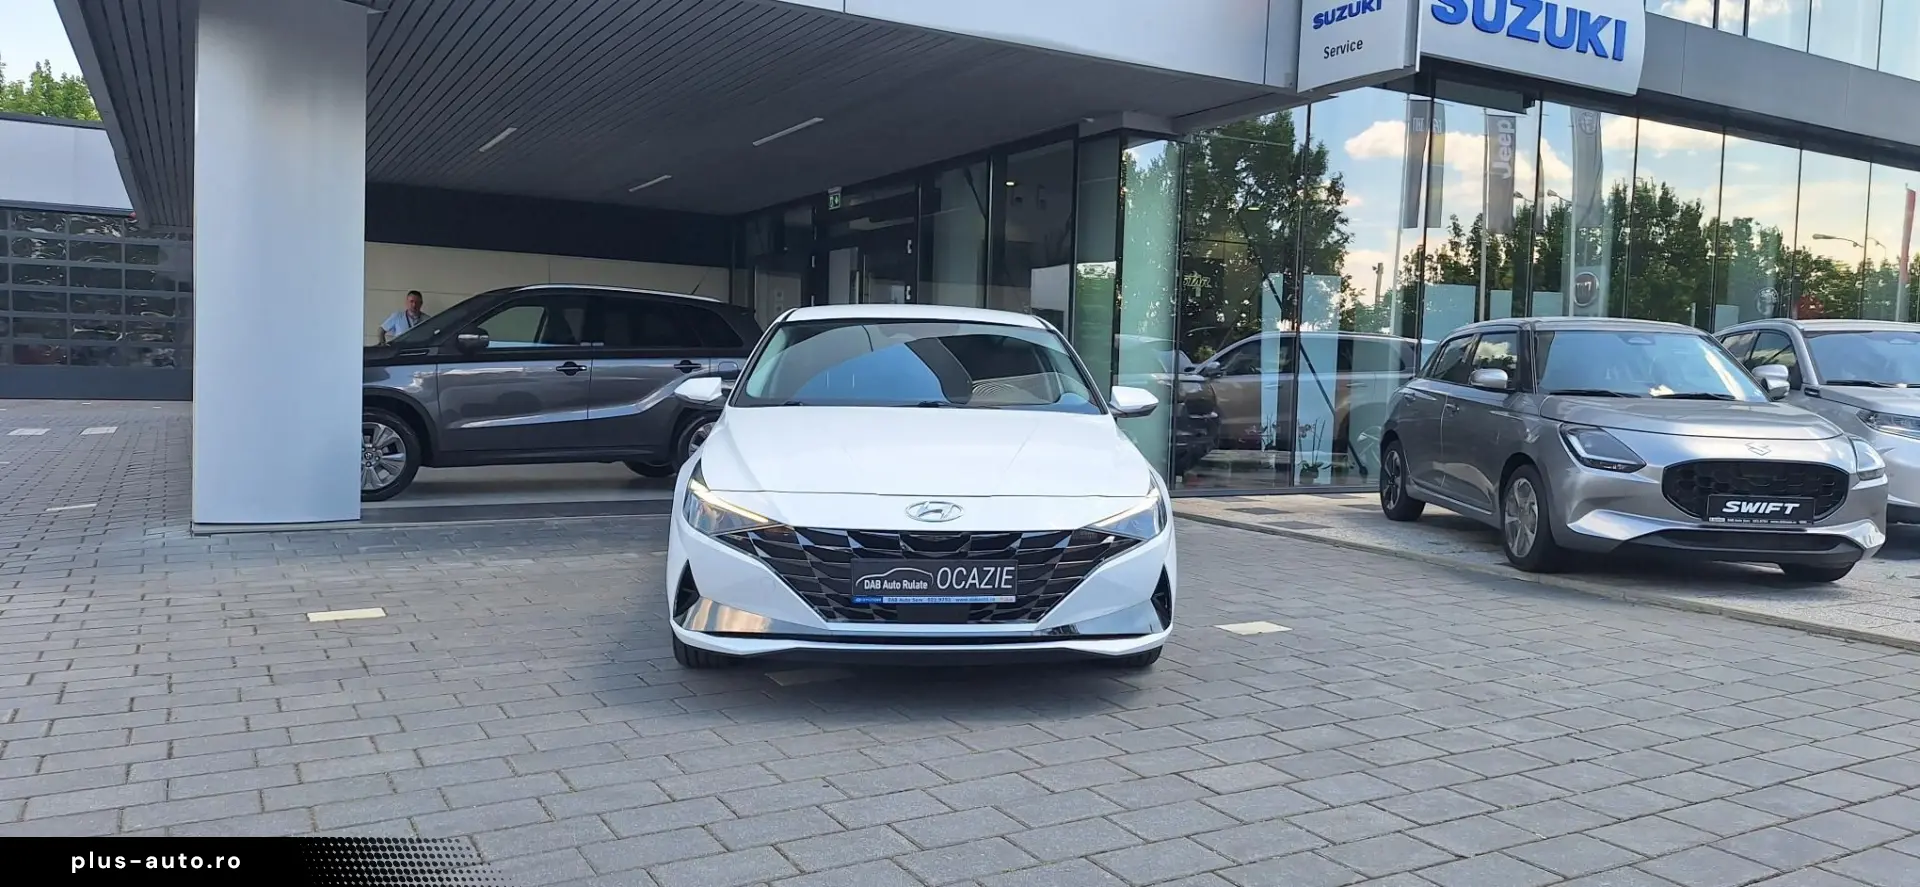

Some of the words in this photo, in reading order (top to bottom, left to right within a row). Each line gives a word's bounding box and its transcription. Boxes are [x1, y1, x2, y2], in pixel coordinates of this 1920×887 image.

[1313, 0, 1382, 29] SUZUKI
[1431, 0, 1627, 61] SUZUKI
[1323, 39, 1363, 59] Service
[1491, 119, 1515, 180] Jeep
[1722, 500, 1800, 514] SWIFT
[864, 579, 881, 589] DAB
[882, 579, 901, 590] Auto
[902, 579, 928, 590] Rulate
[936, 566, 1015, 589] OCAZIE
